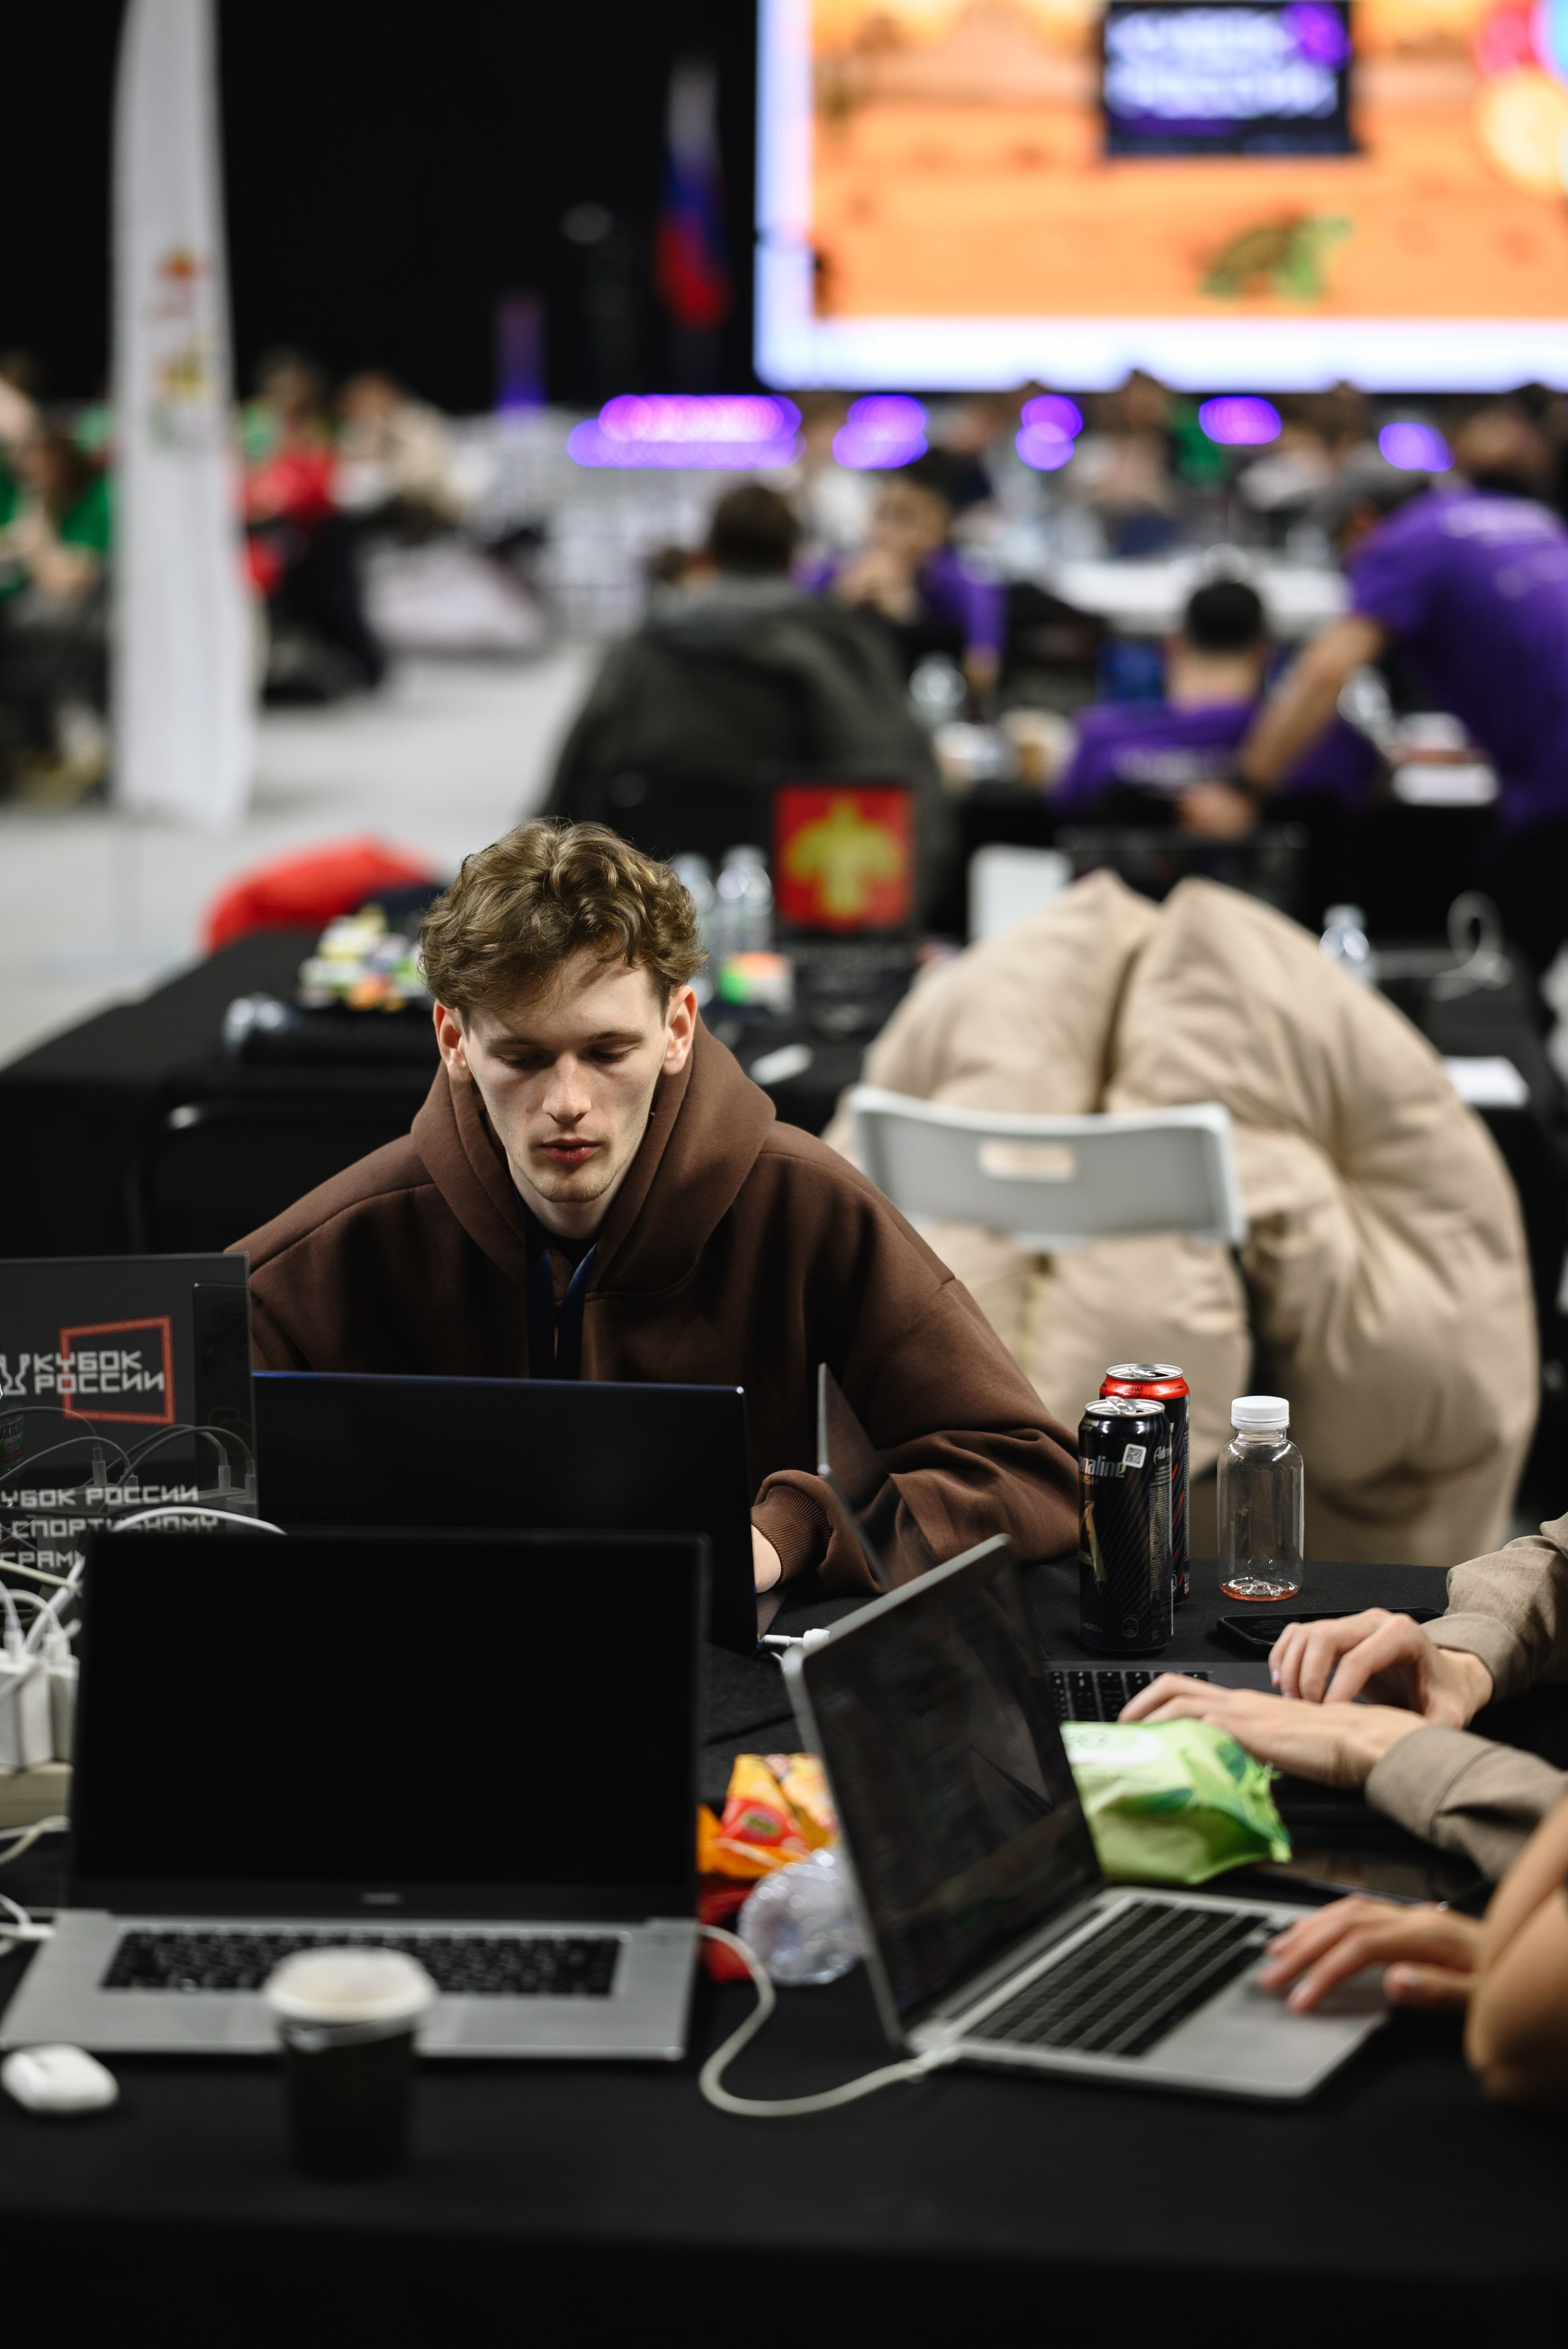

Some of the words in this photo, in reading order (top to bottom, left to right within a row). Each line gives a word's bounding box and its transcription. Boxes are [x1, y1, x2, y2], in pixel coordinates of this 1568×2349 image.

[33, 1349, 143, 1373] КУБОК
[34, 1370, 165, 1395] РОССИИ
[0, 1488, 77, 1509] УБОК
[85, 1484, 199, 1506] РОССИИ
